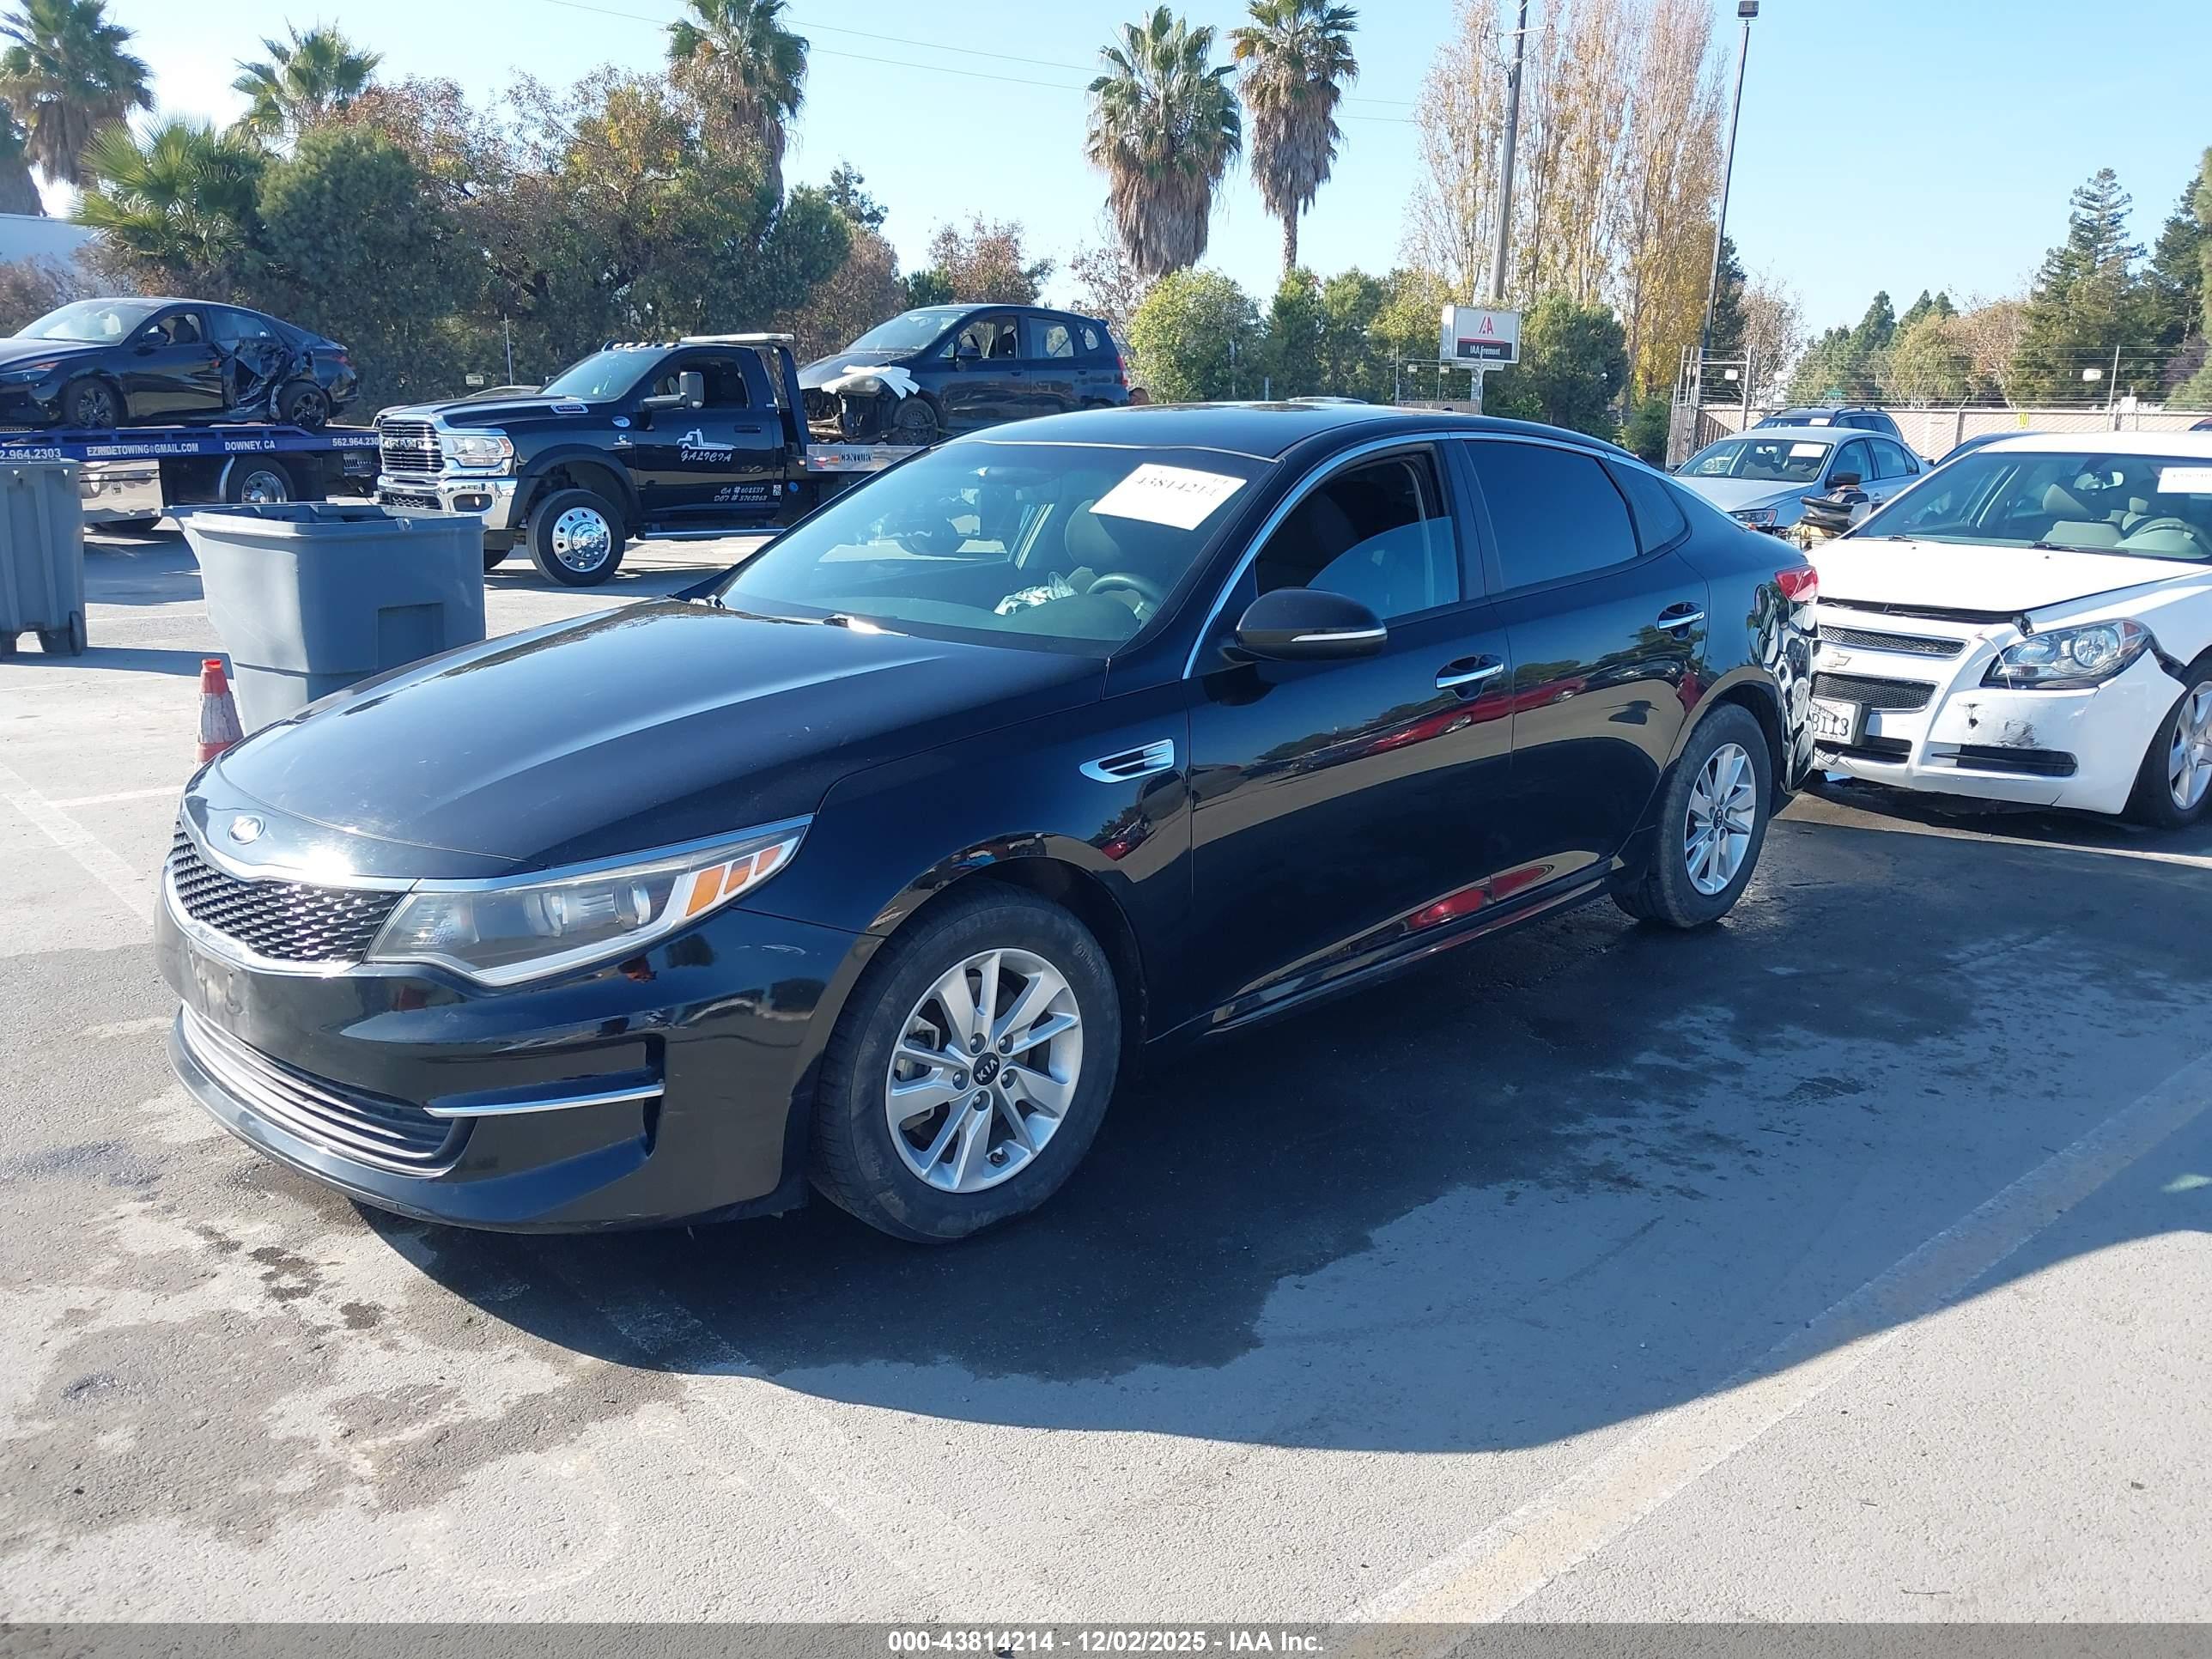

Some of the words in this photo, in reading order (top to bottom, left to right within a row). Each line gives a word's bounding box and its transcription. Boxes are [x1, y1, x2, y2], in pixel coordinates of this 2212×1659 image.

[1469, 344, 1480, 355] IAA
[1480, 345, 1501, 356] Fremont
[264, 440, 276, 450] CA
[680, 450, 732, 462] GALICIA
[838, 453, 872, 463] CENTURY
[975, 1059, 999, 1082] KIA
